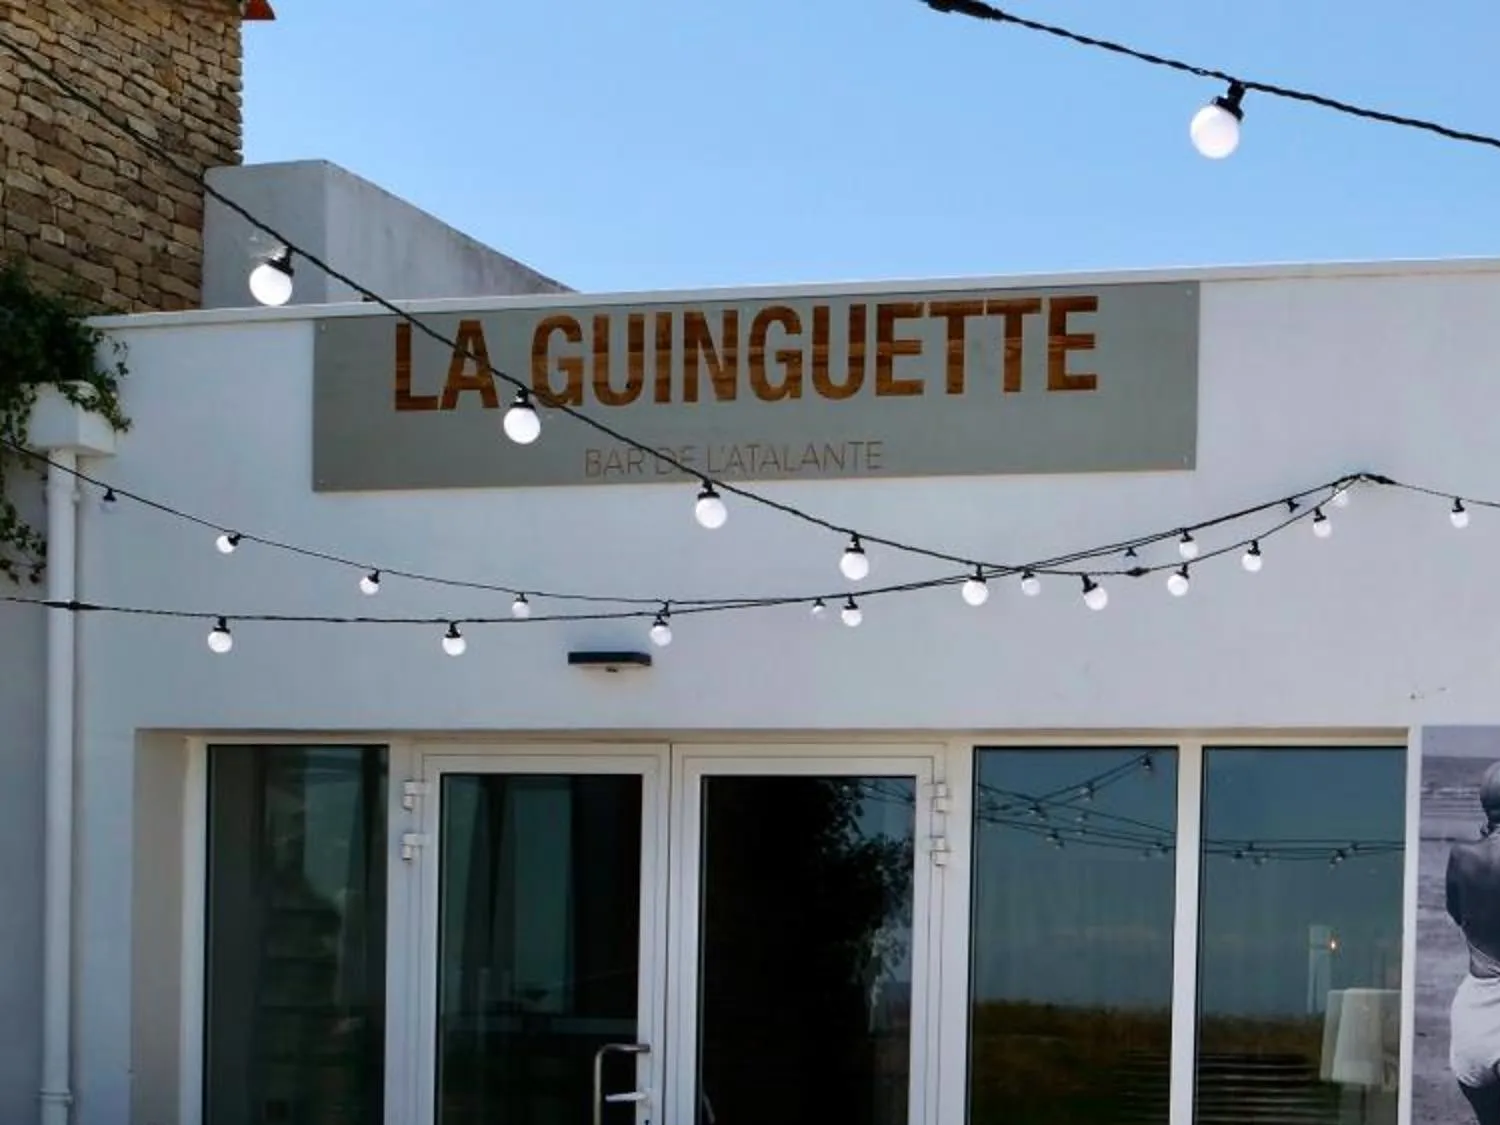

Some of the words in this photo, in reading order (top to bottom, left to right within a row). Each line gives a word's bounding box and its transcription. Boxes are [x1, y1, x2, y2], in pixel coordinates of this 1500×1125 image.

[395, 319, 499, 411] LA
[531, 295, 1098, 408] GUINGUETTE
[585, 448, 643, 478] BAR
[654, 446, 696, 475] DE
[707, 441, 883, 473] L'ATALANTE
